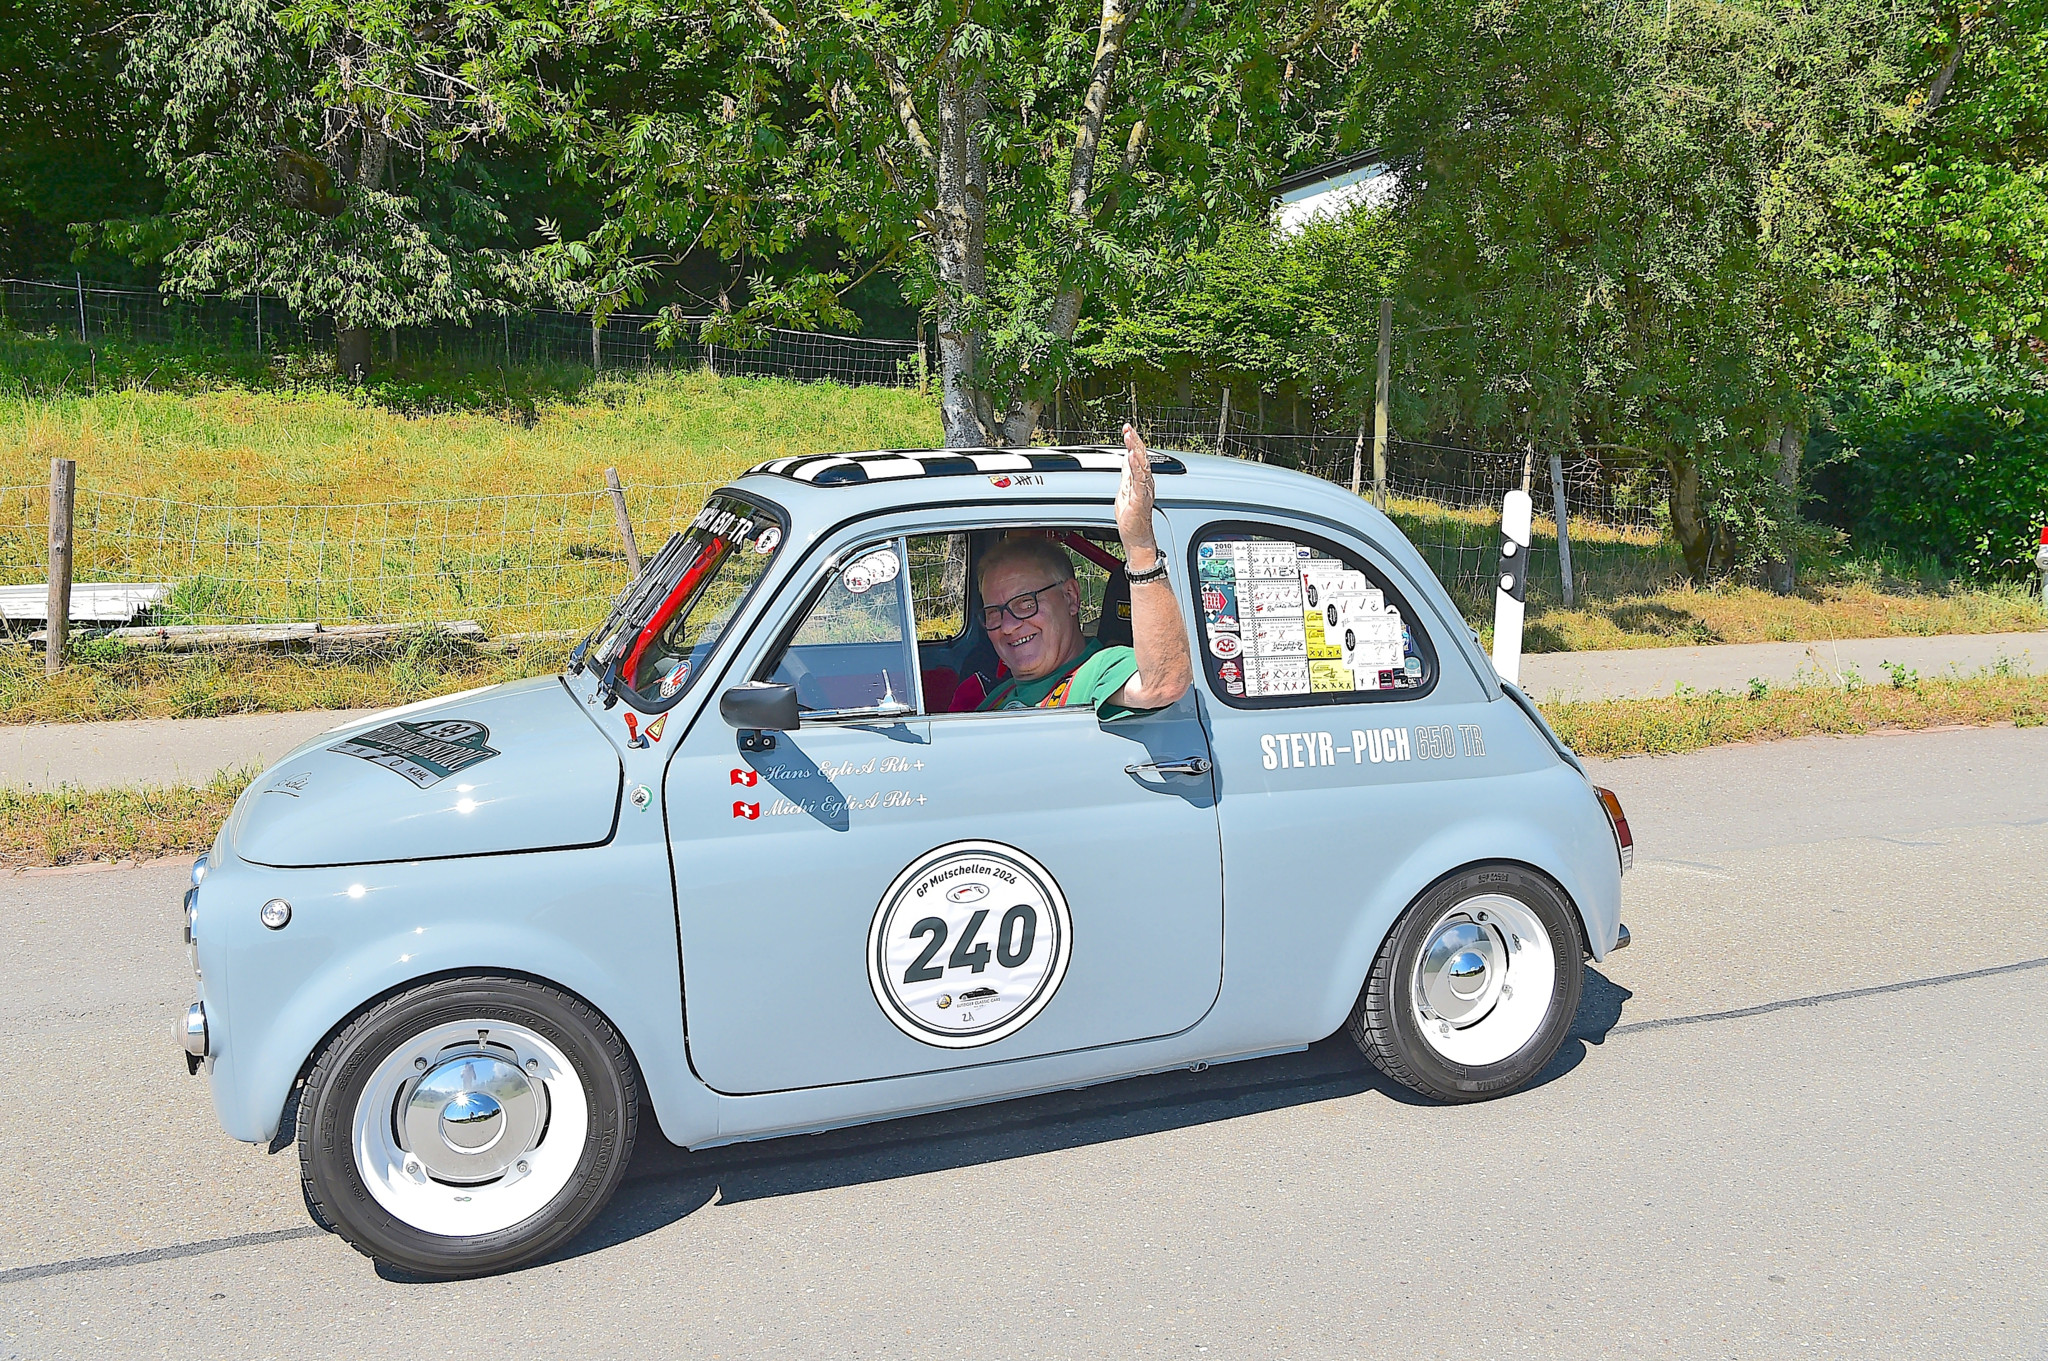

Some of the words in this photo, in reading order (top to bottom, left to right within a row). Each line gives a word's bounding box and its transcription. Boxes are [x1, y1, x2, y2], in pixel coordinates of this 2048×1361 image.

[709, 511, 736, 536] 650
[727, 517, 753, 545] TR
[430, 724, 471, 738] 99
[414, 740, 493, 771] HISTORIC
[1260, 727, 1412, 770] STEYR-PUCH
[1414, 725, 1456, 760] 650
[1457, 724, 1487, 757] TR
[406, 767, 429, 781] KAHL
[763, 763, 812, 781] Hans
[818, 760, 854, 782] Egli
[854, 757, 876, 774] A
[763, 798, 818, 817] Michi
[820, 794, 858, 818] Egli
[857, 791, 880, 809] A
[916, 883, 930, 898] GP
[930, 864, 992, 888] Mutschellen
[992, 867, 1018, 885] 2026
[903, 904, 1037, 984] 240
